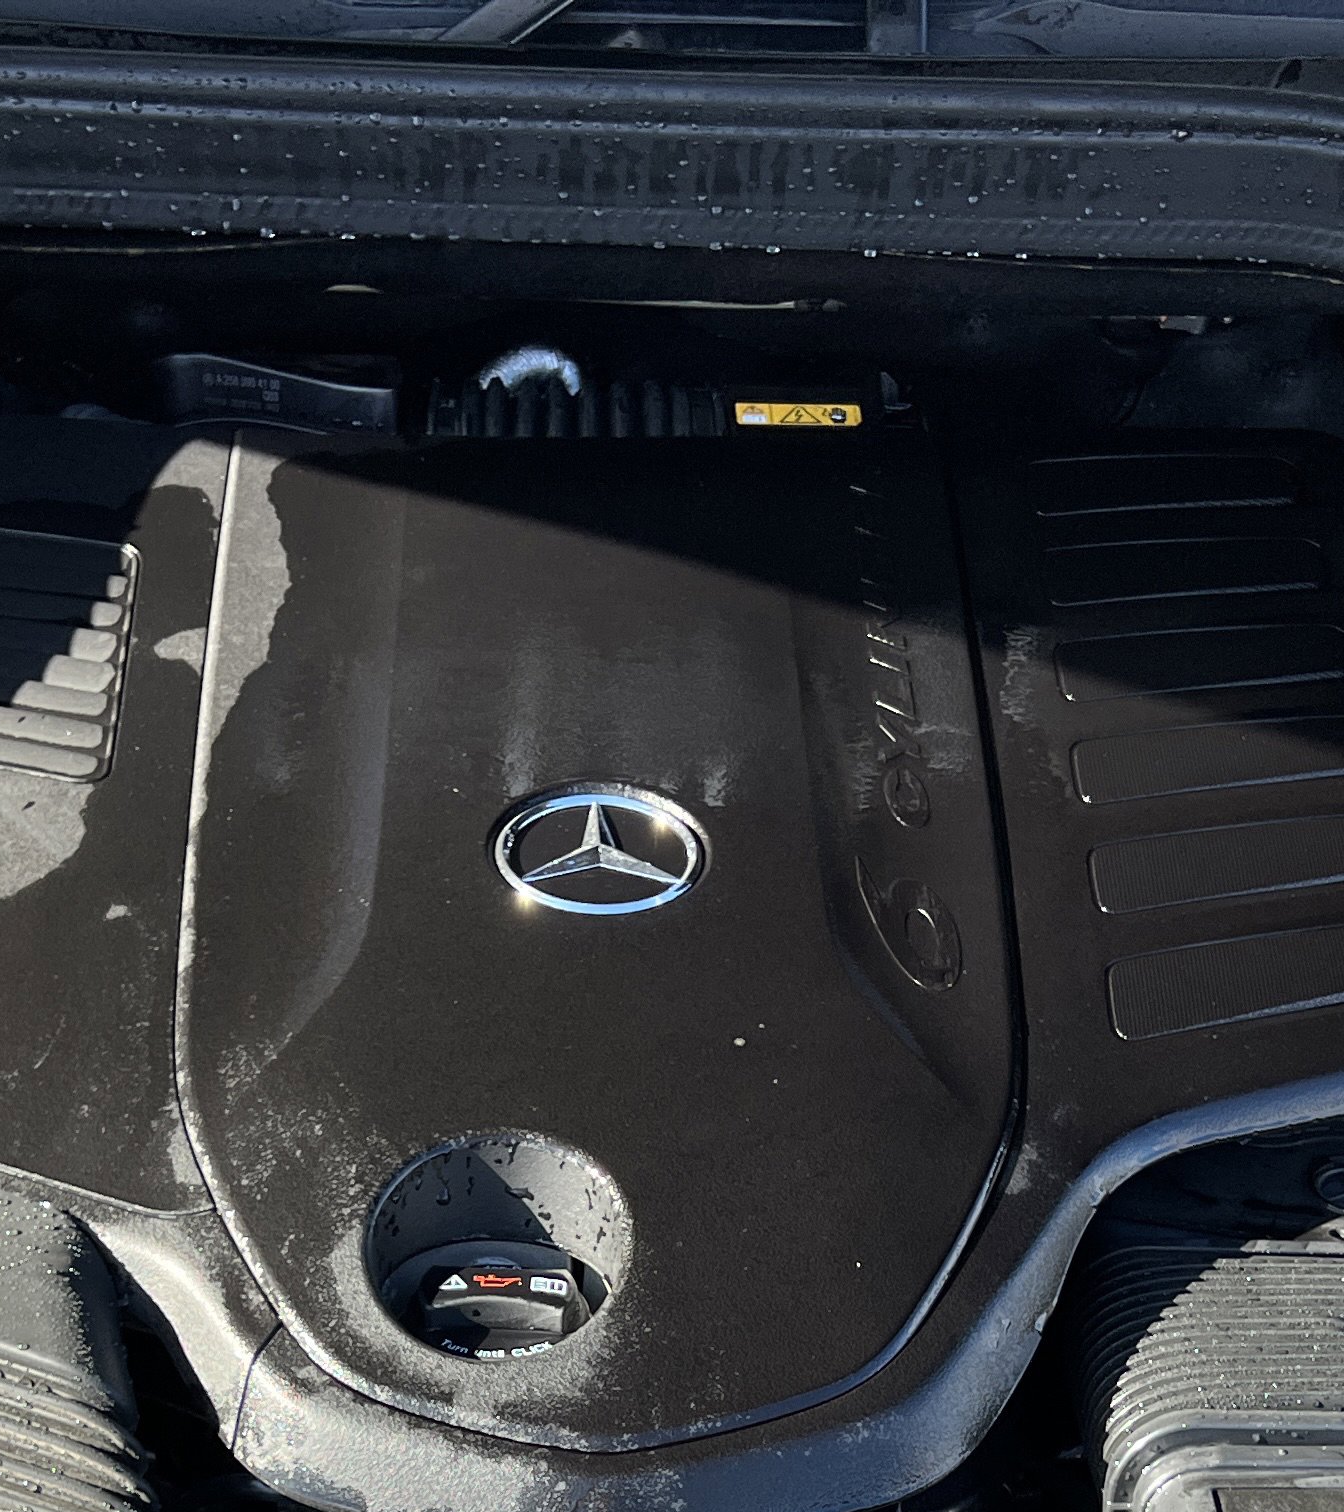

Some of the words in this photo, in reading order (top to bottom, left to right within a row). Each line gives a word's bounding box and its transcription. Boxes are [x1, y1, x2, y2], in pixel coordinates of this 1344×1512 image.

[848, 474, 930, 829] CYLIN
[855, 854, 962, 994] 6
[440, 1338, 469, 1354] Turn
[510, 1340, 553, 1357] CLICK
